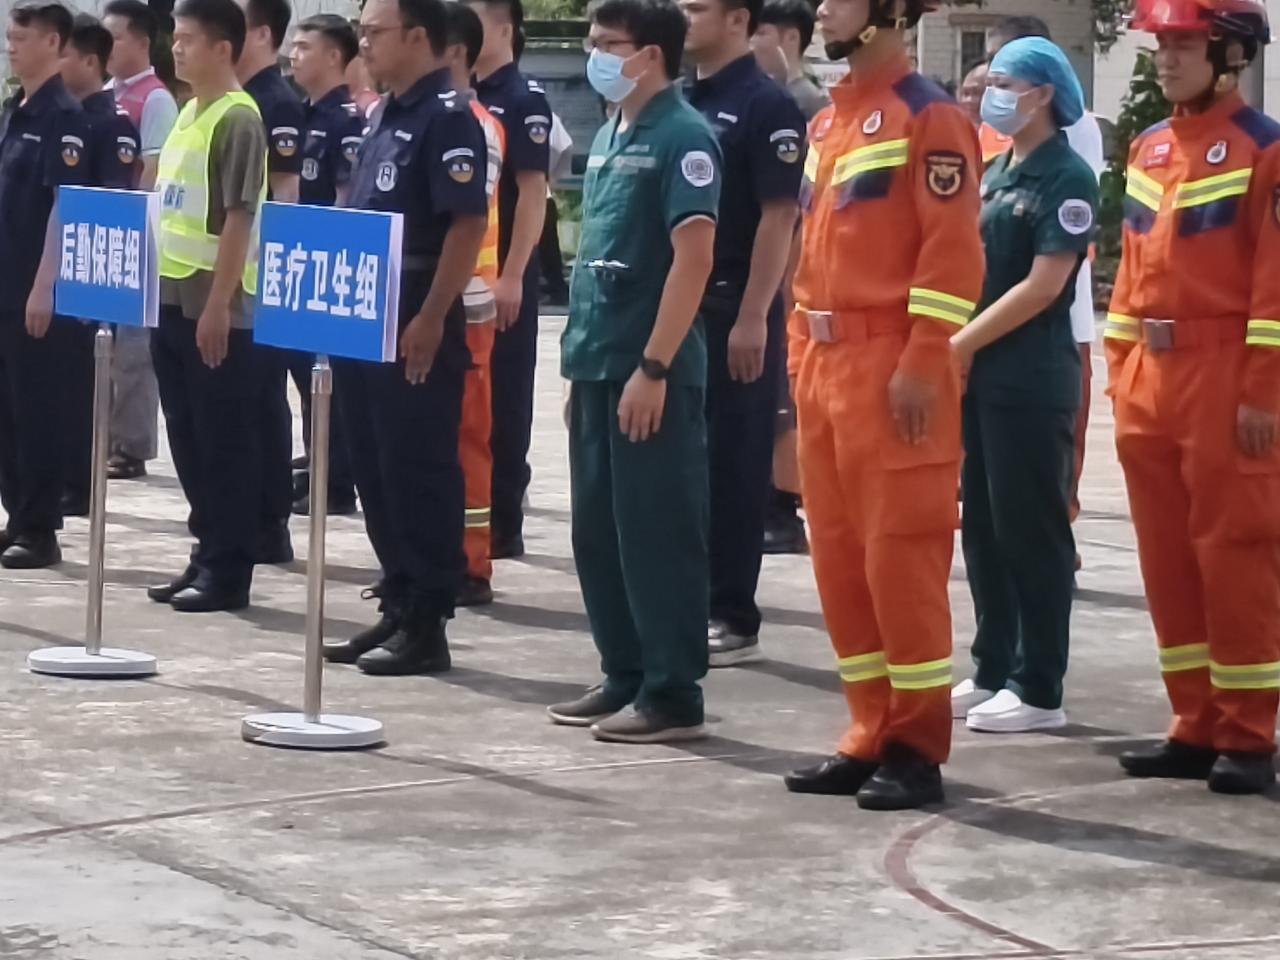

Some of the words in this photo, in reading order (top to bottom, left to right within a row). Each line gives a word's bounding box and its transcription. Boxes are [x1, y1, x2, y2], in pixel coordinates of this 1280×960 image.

[60, 222, 140, 290] 后勤保障组
[262, 241, 379, 320] 医疗卫生组
